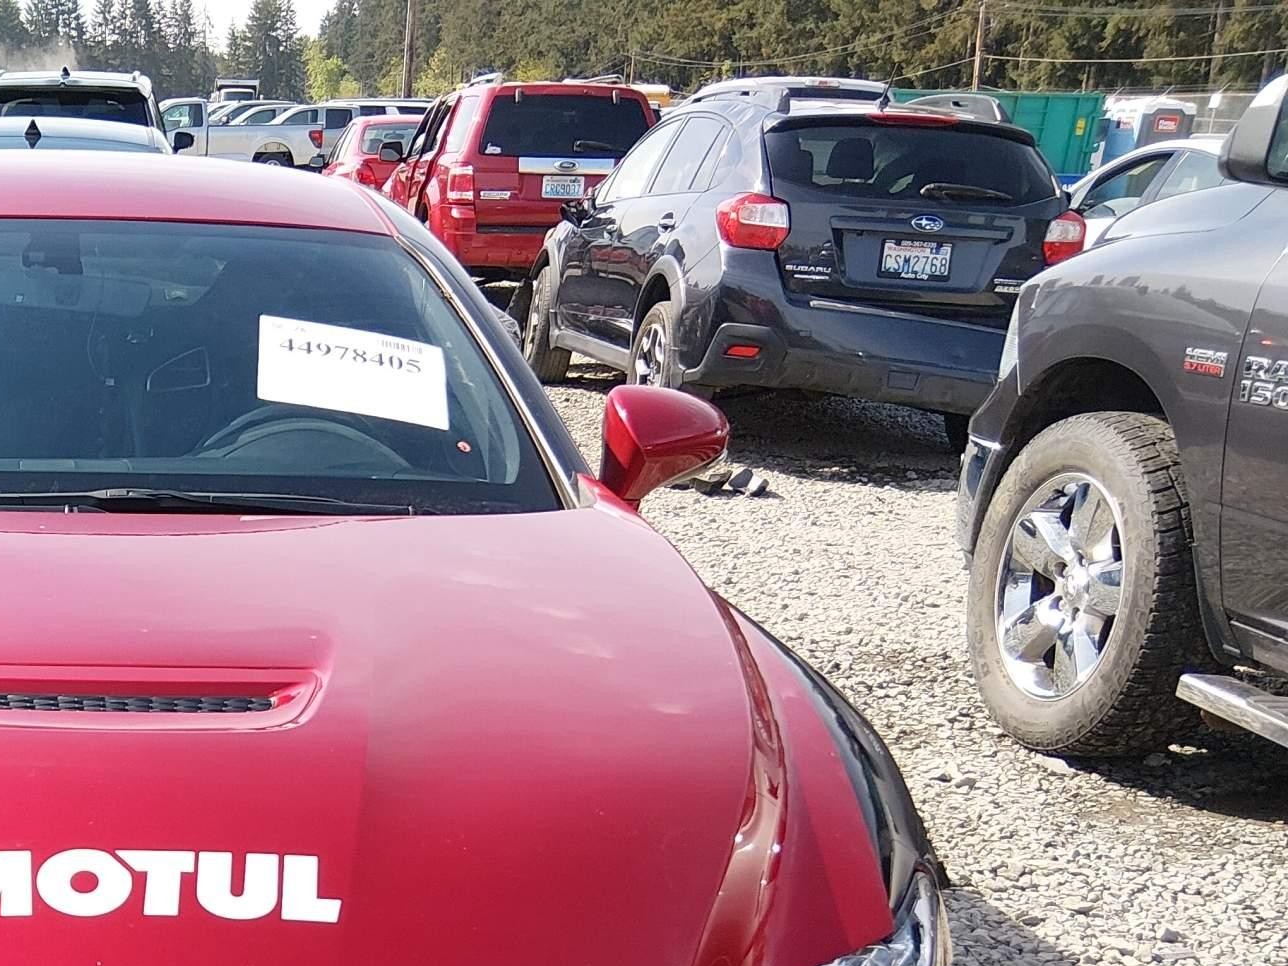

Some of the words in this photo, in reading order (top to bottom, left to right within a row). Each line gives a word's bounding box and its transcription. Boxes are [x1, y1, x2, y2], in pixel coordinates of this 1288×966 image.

[785, 264, 832, 273] SUBARU
[884, 255, 948, 275] CSM2768
[279, 337, 422, 374] 44978405
